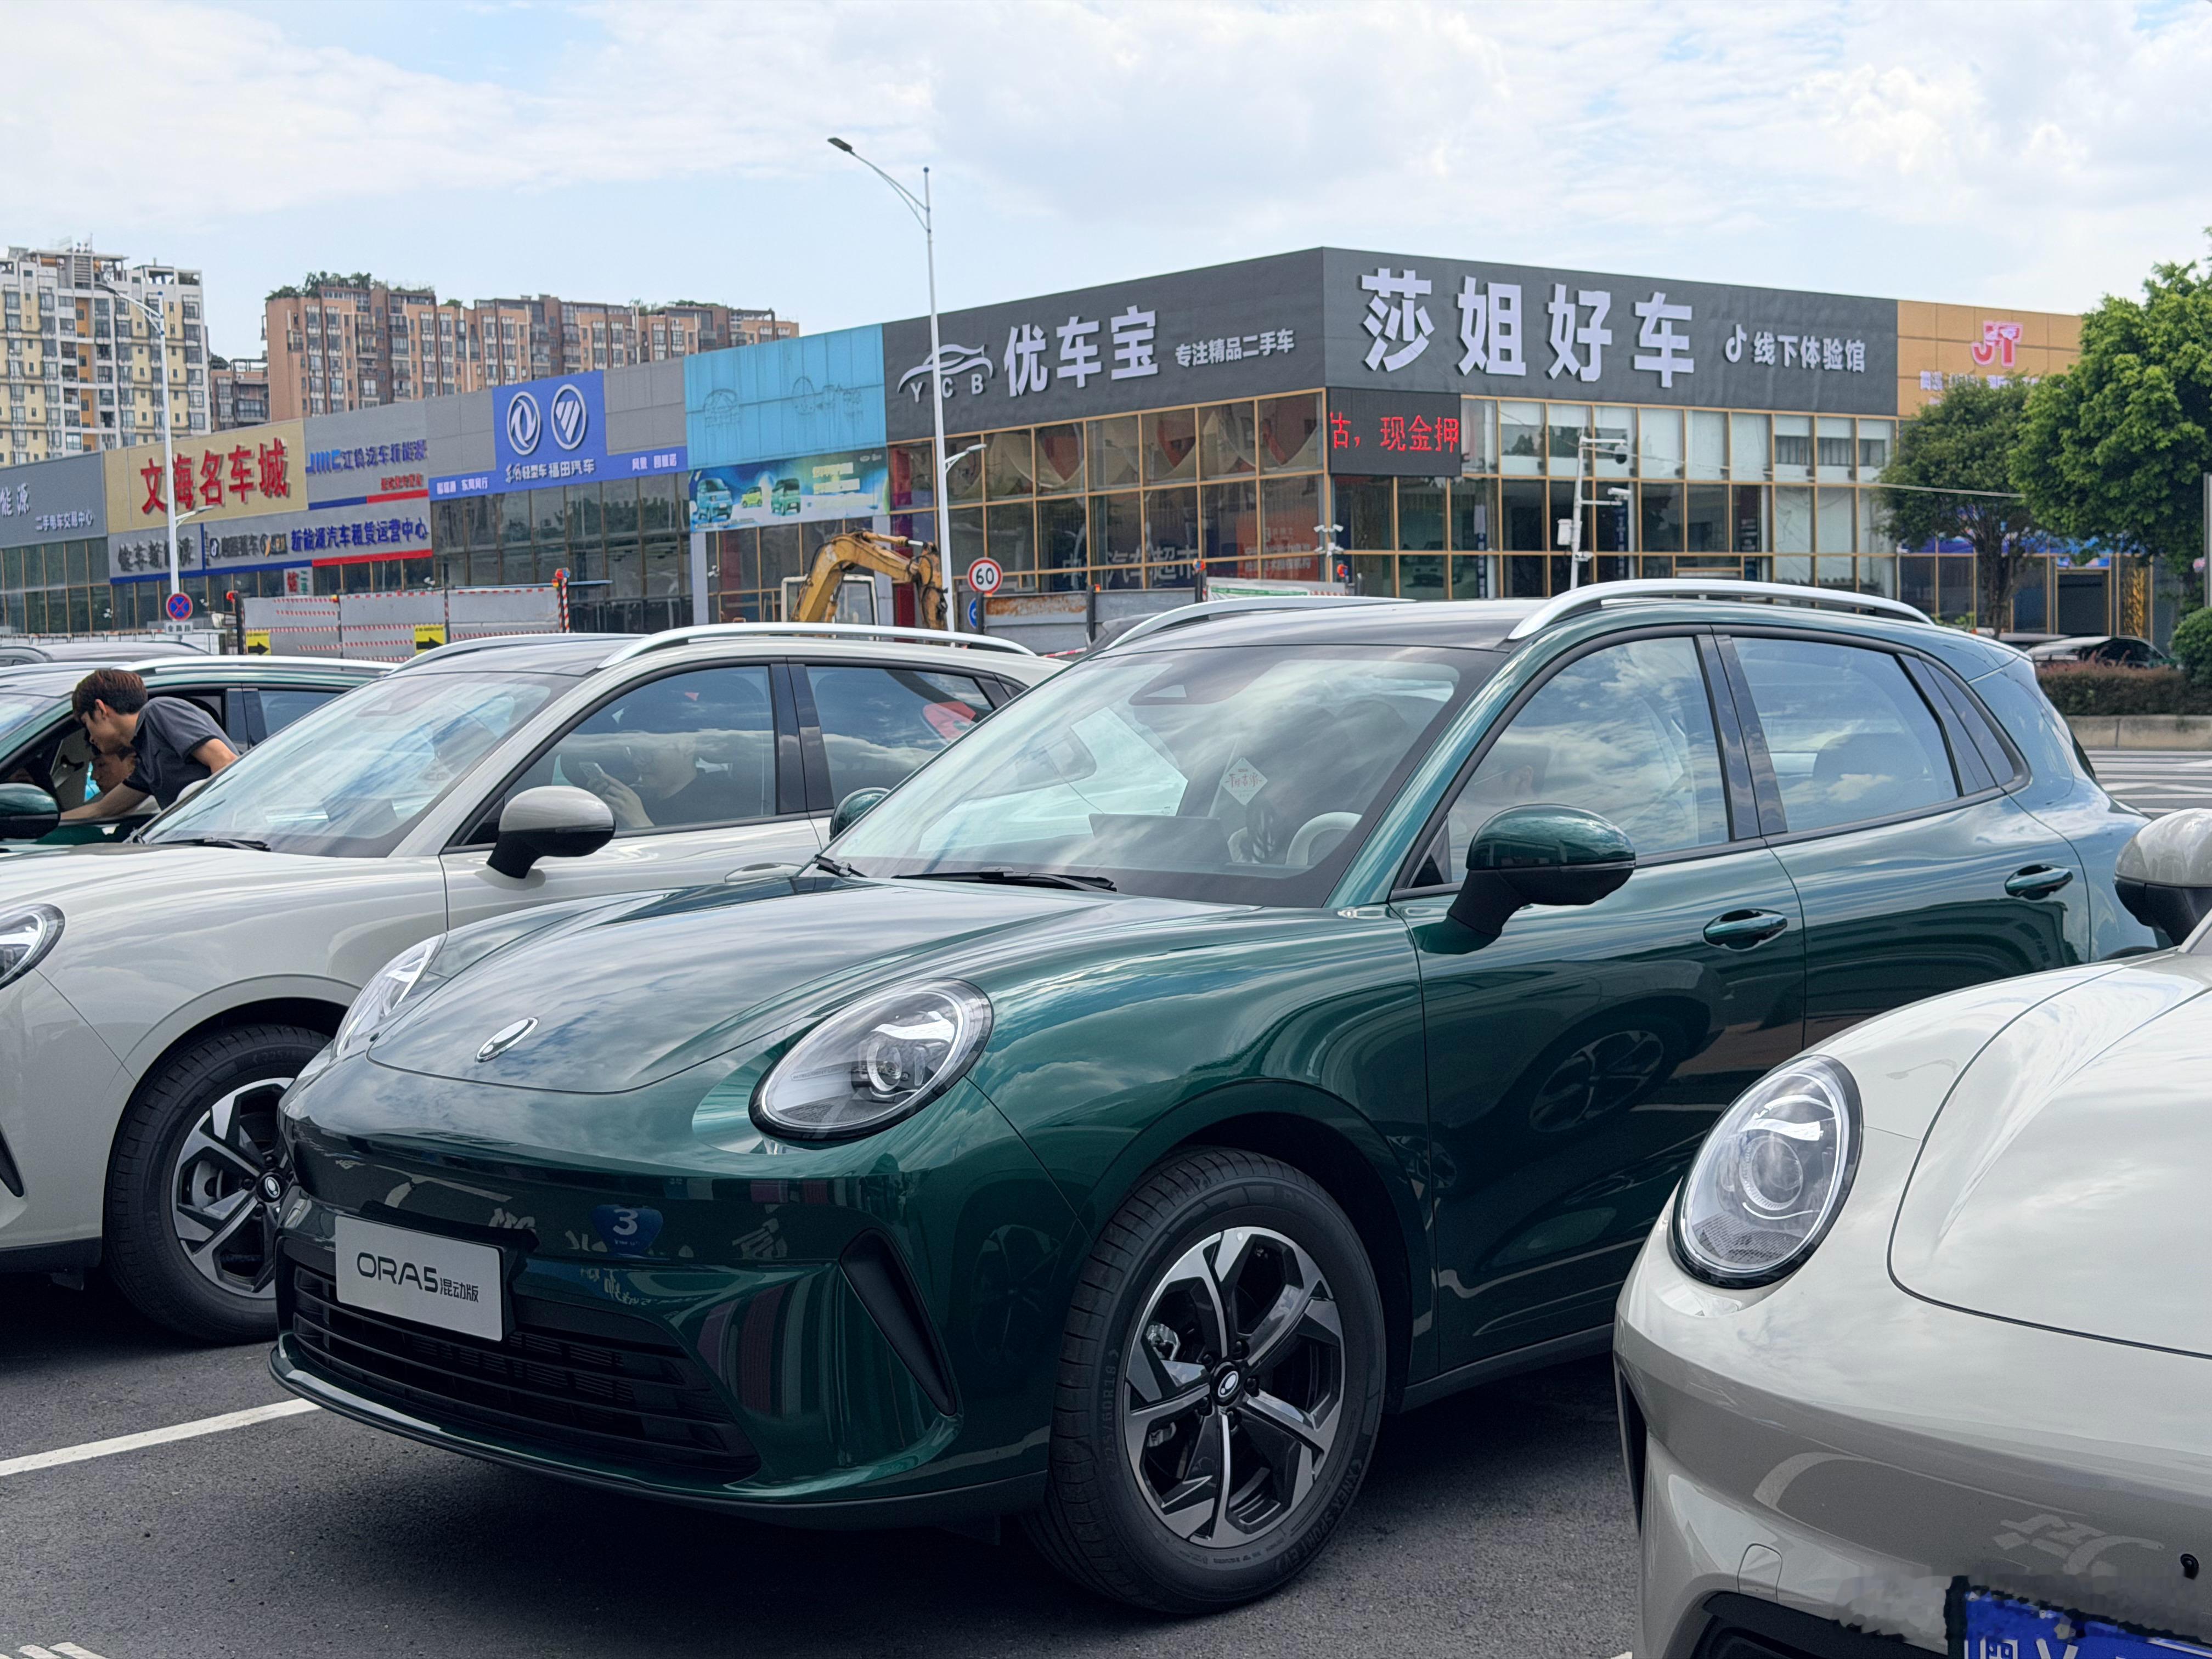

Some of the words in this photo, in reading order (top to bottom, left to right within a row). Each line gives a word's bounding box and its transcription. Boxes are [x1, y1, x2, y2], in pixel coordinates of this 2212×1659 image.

[1361, 267, 1695, 388] 莎姐好车
[1003, 305, 1159, 397] 优车宝
[1175, 329, 1295, 368] 专注精品二手车
[1753, 328, 1866, 374] 线下体验馆
[305, 449, 342, 475] JMC
[549, 459, 595, 478] 福田汽车
[291, 517, 430, 552] 新能源汽车租赁运营中心
[975, 567, 994, 585] 60
[357, 1251, 438, 1293] ORA5
[440, 1278, 479, 1304] 混动版
